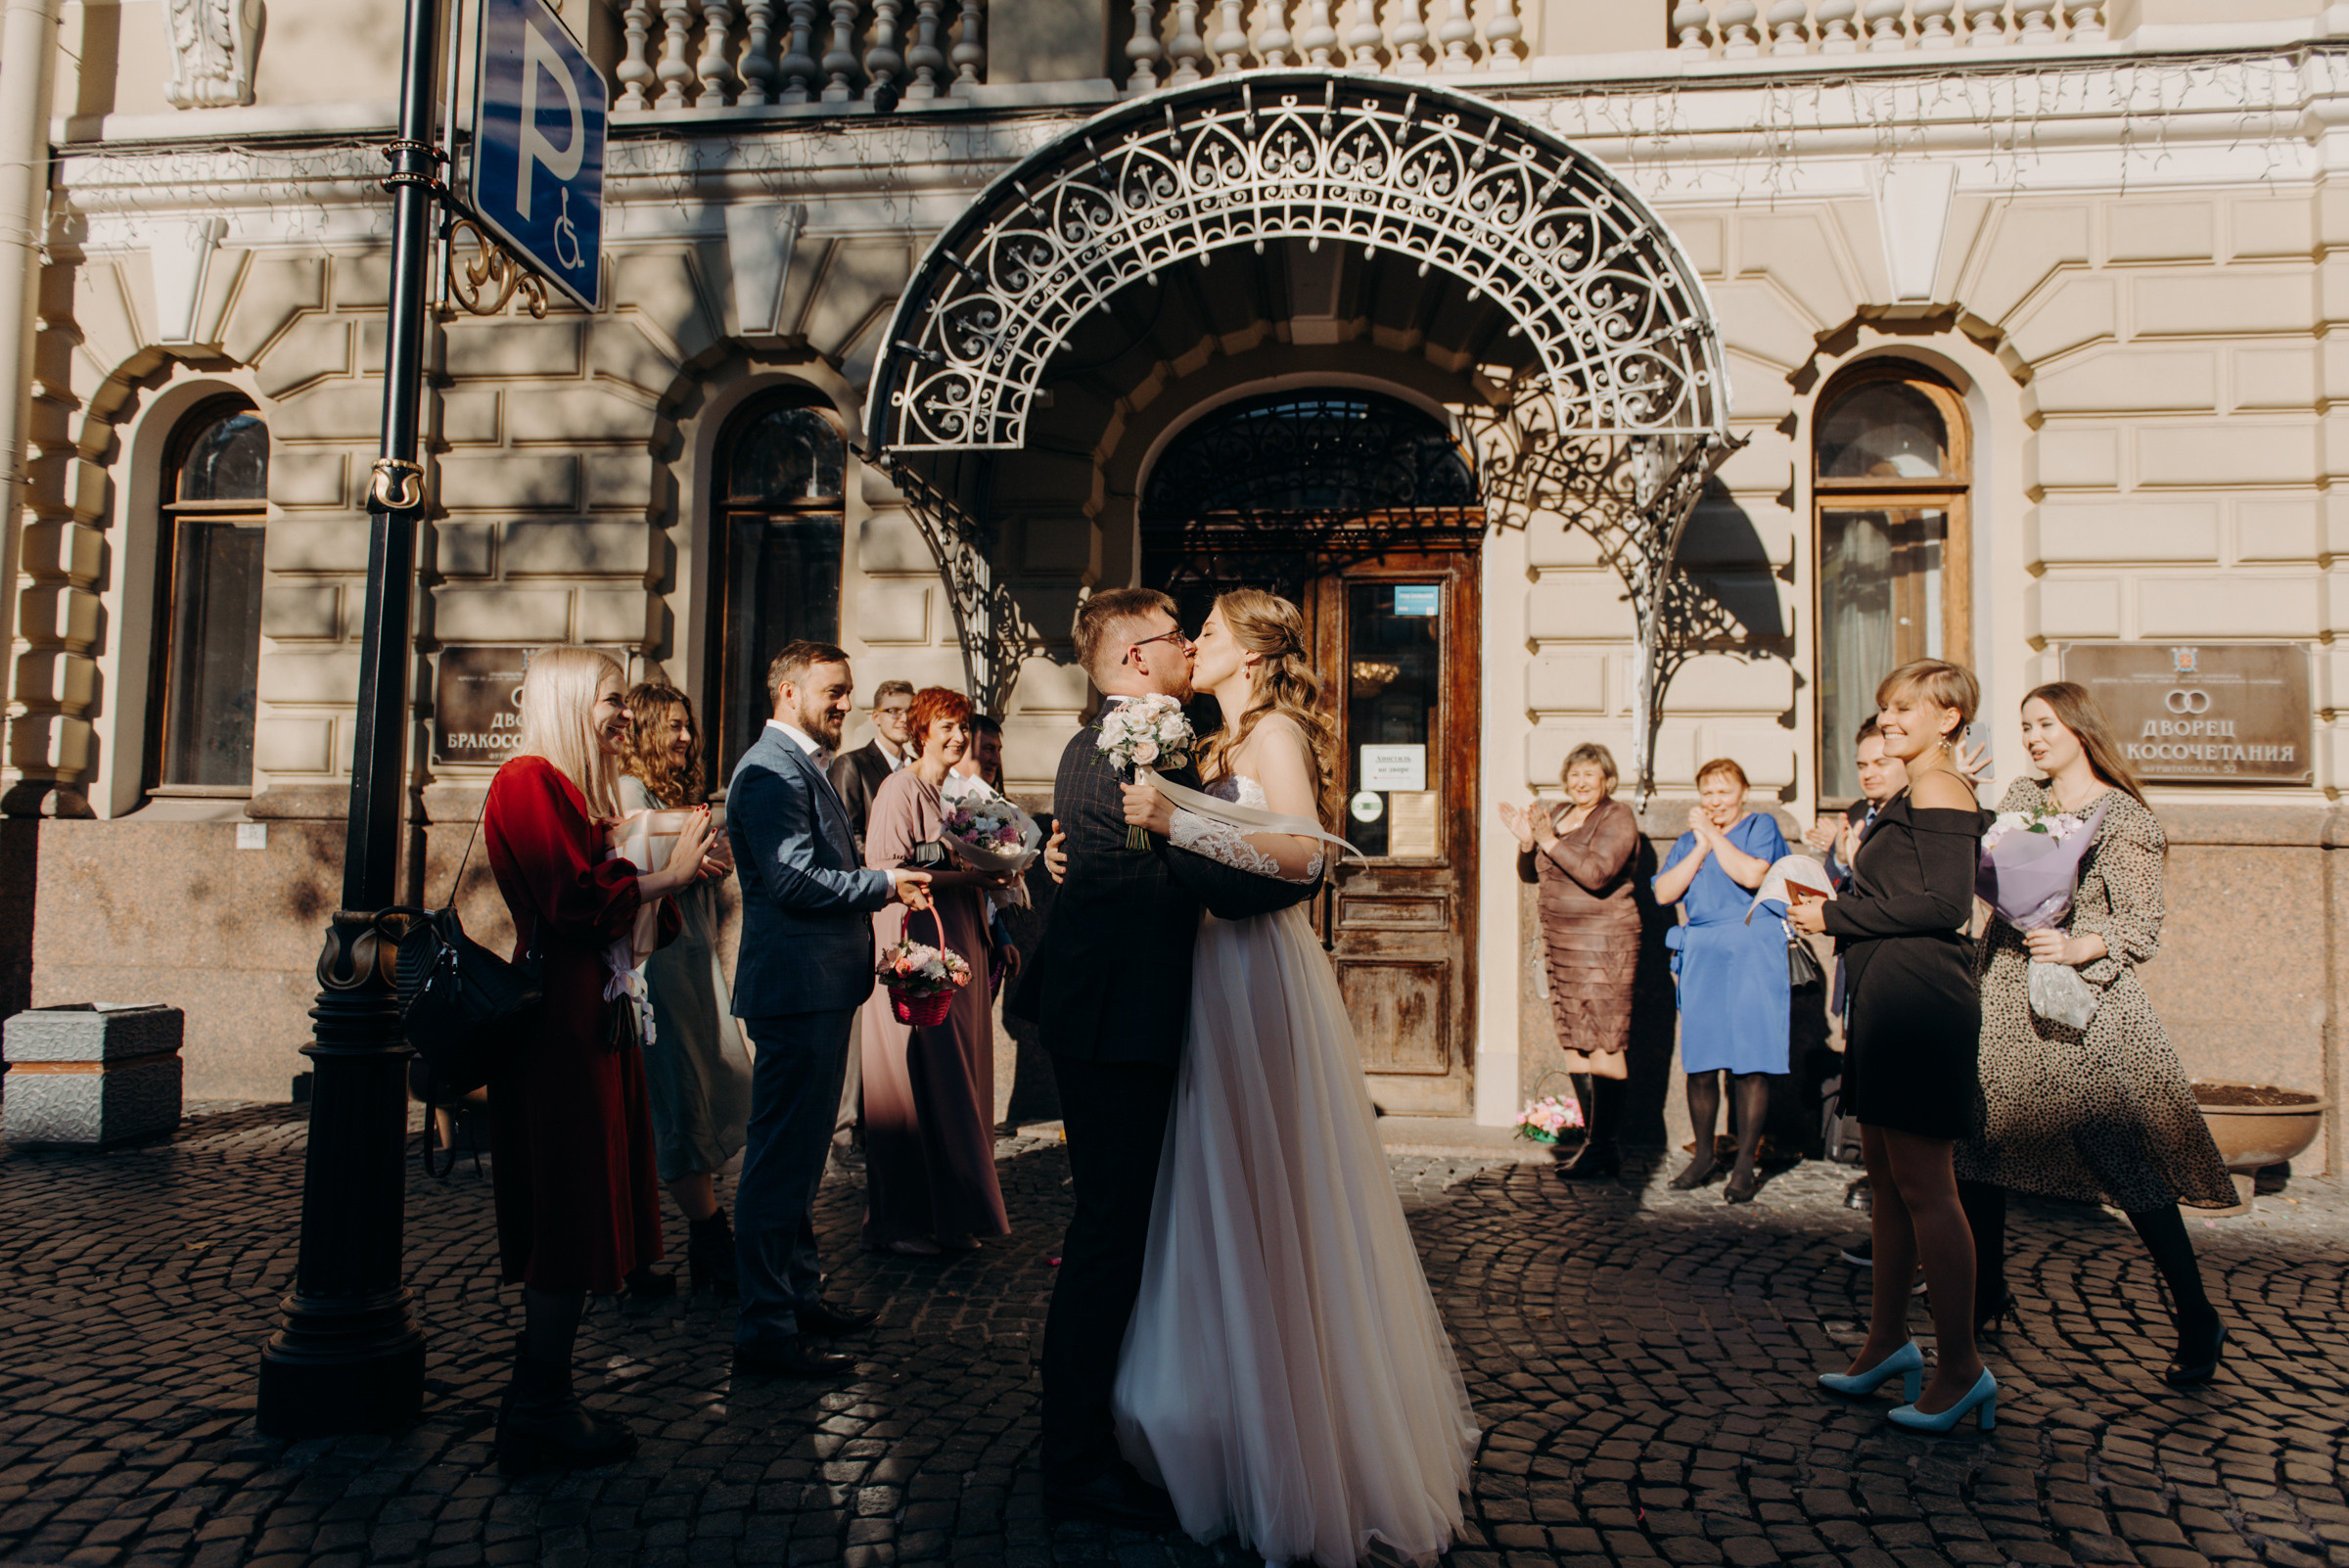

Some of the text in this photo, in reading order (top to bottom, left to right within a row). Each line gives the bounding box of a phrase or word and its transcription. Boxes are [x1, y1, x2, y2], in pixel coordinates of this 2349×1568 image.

[516, 18, 585, 223] P
[490, 713, 525, 729] ДВО
[2142, 719, 2236, 738] ДВОРЕЦ
[447, 733, 524, 749] БРАКОСО
[2118, 743, 2295, 762] КОСОЧЕТАНИЯ
[2223, 764, 2237, 774] 52
